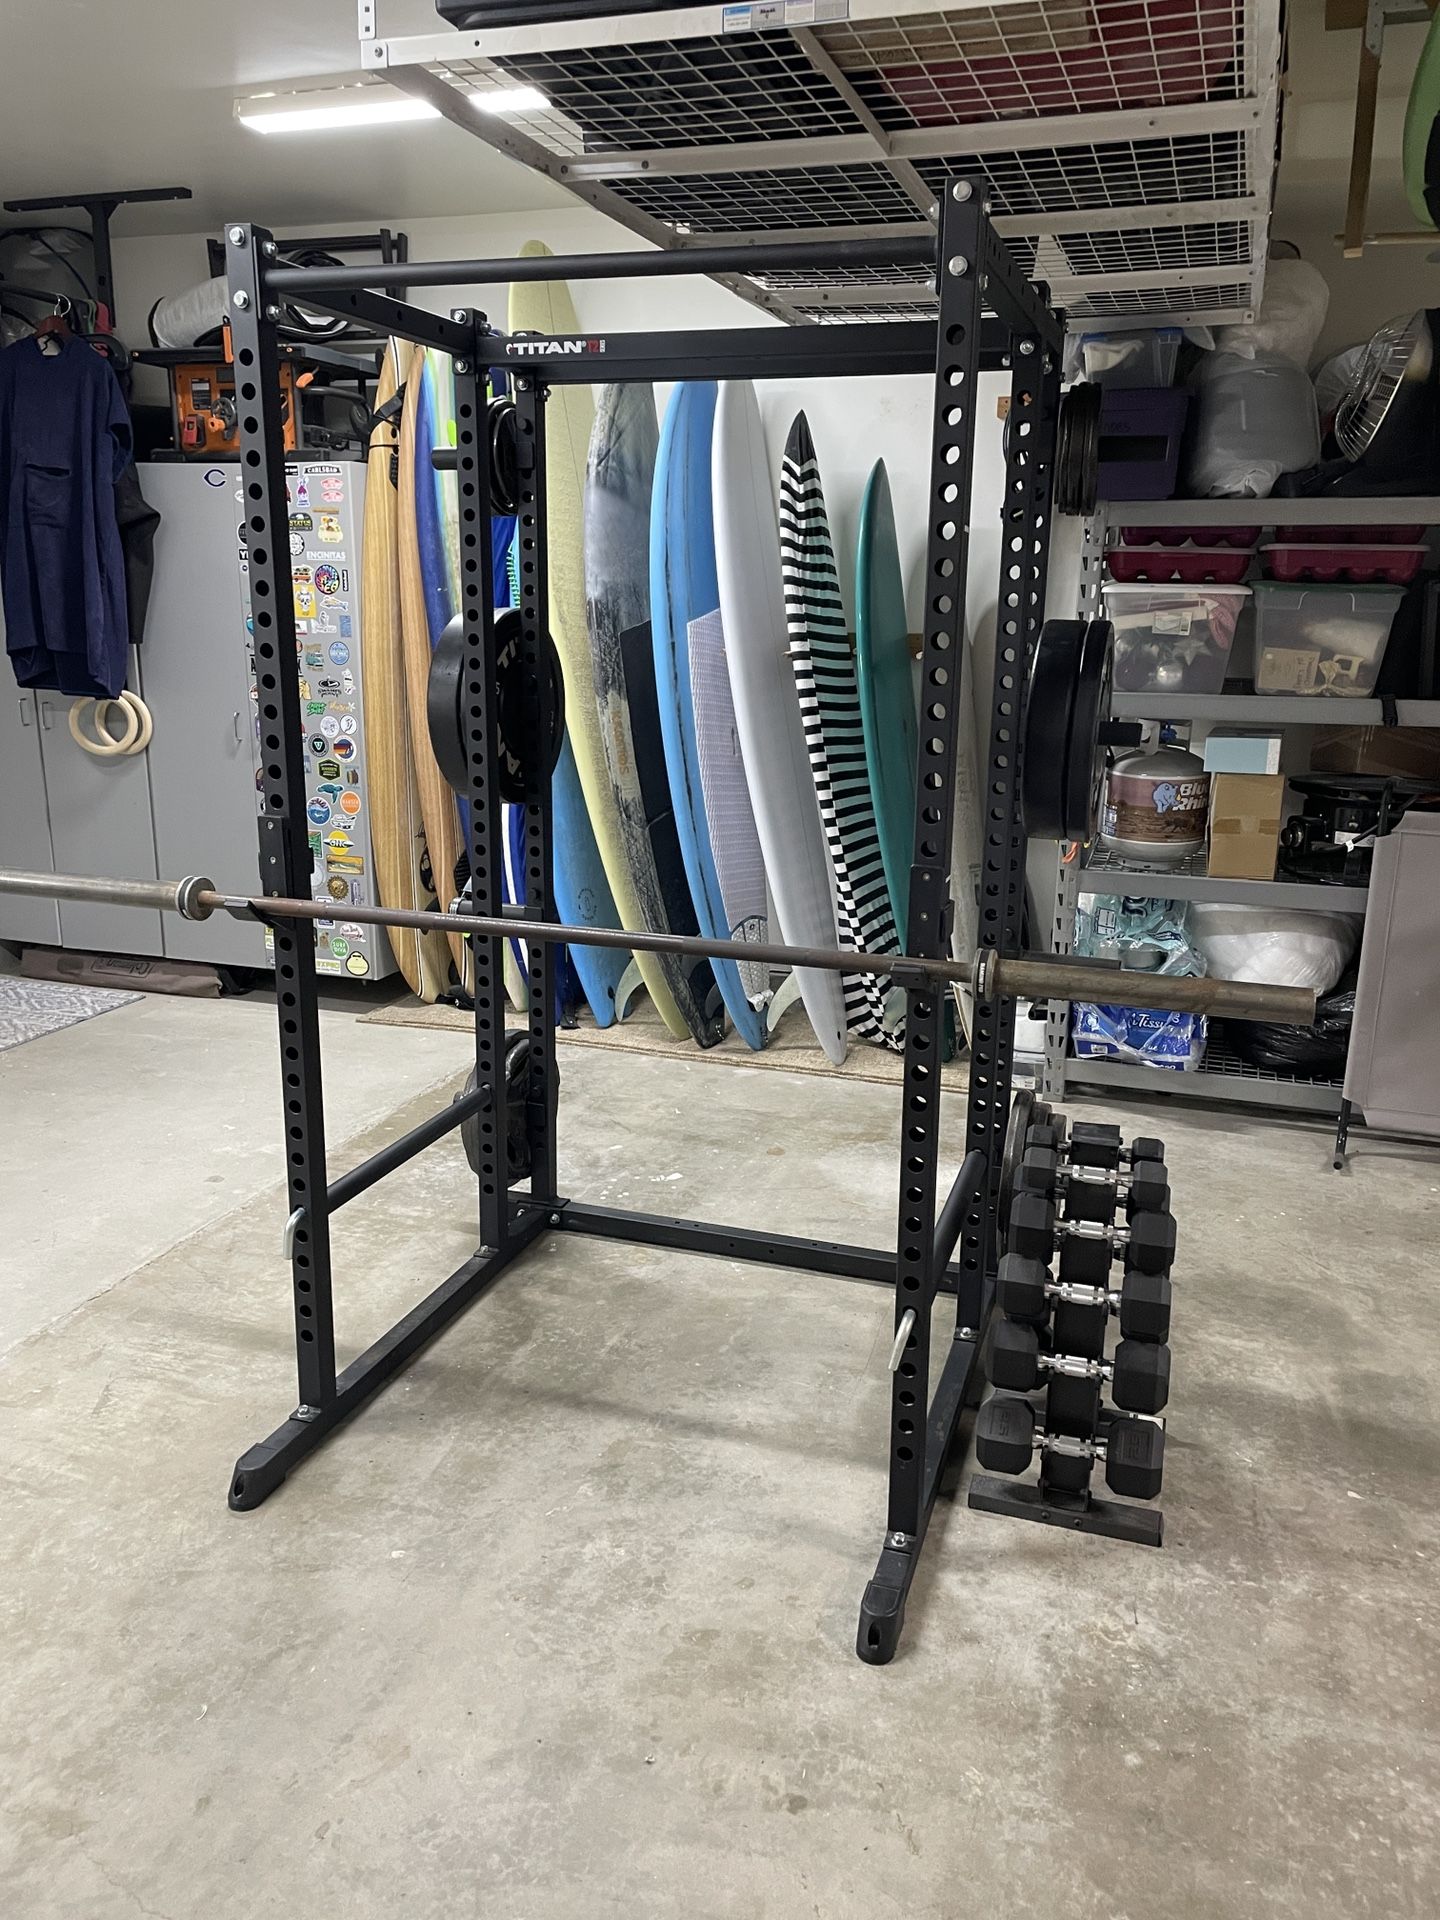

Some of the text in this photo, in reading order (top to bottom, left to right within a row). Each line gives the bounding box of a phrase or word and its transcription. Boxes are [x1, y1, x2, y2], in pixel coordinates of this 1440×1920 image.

[513, 340, 582, 355] TITAN
[307, 465, 338, 473] CARLSBAD
[306, 551, 346, 559] ENCINITAS
[1172, 796, 1208, 811] Rhin
[1138, 1013, 1166, 1029] Tissu
